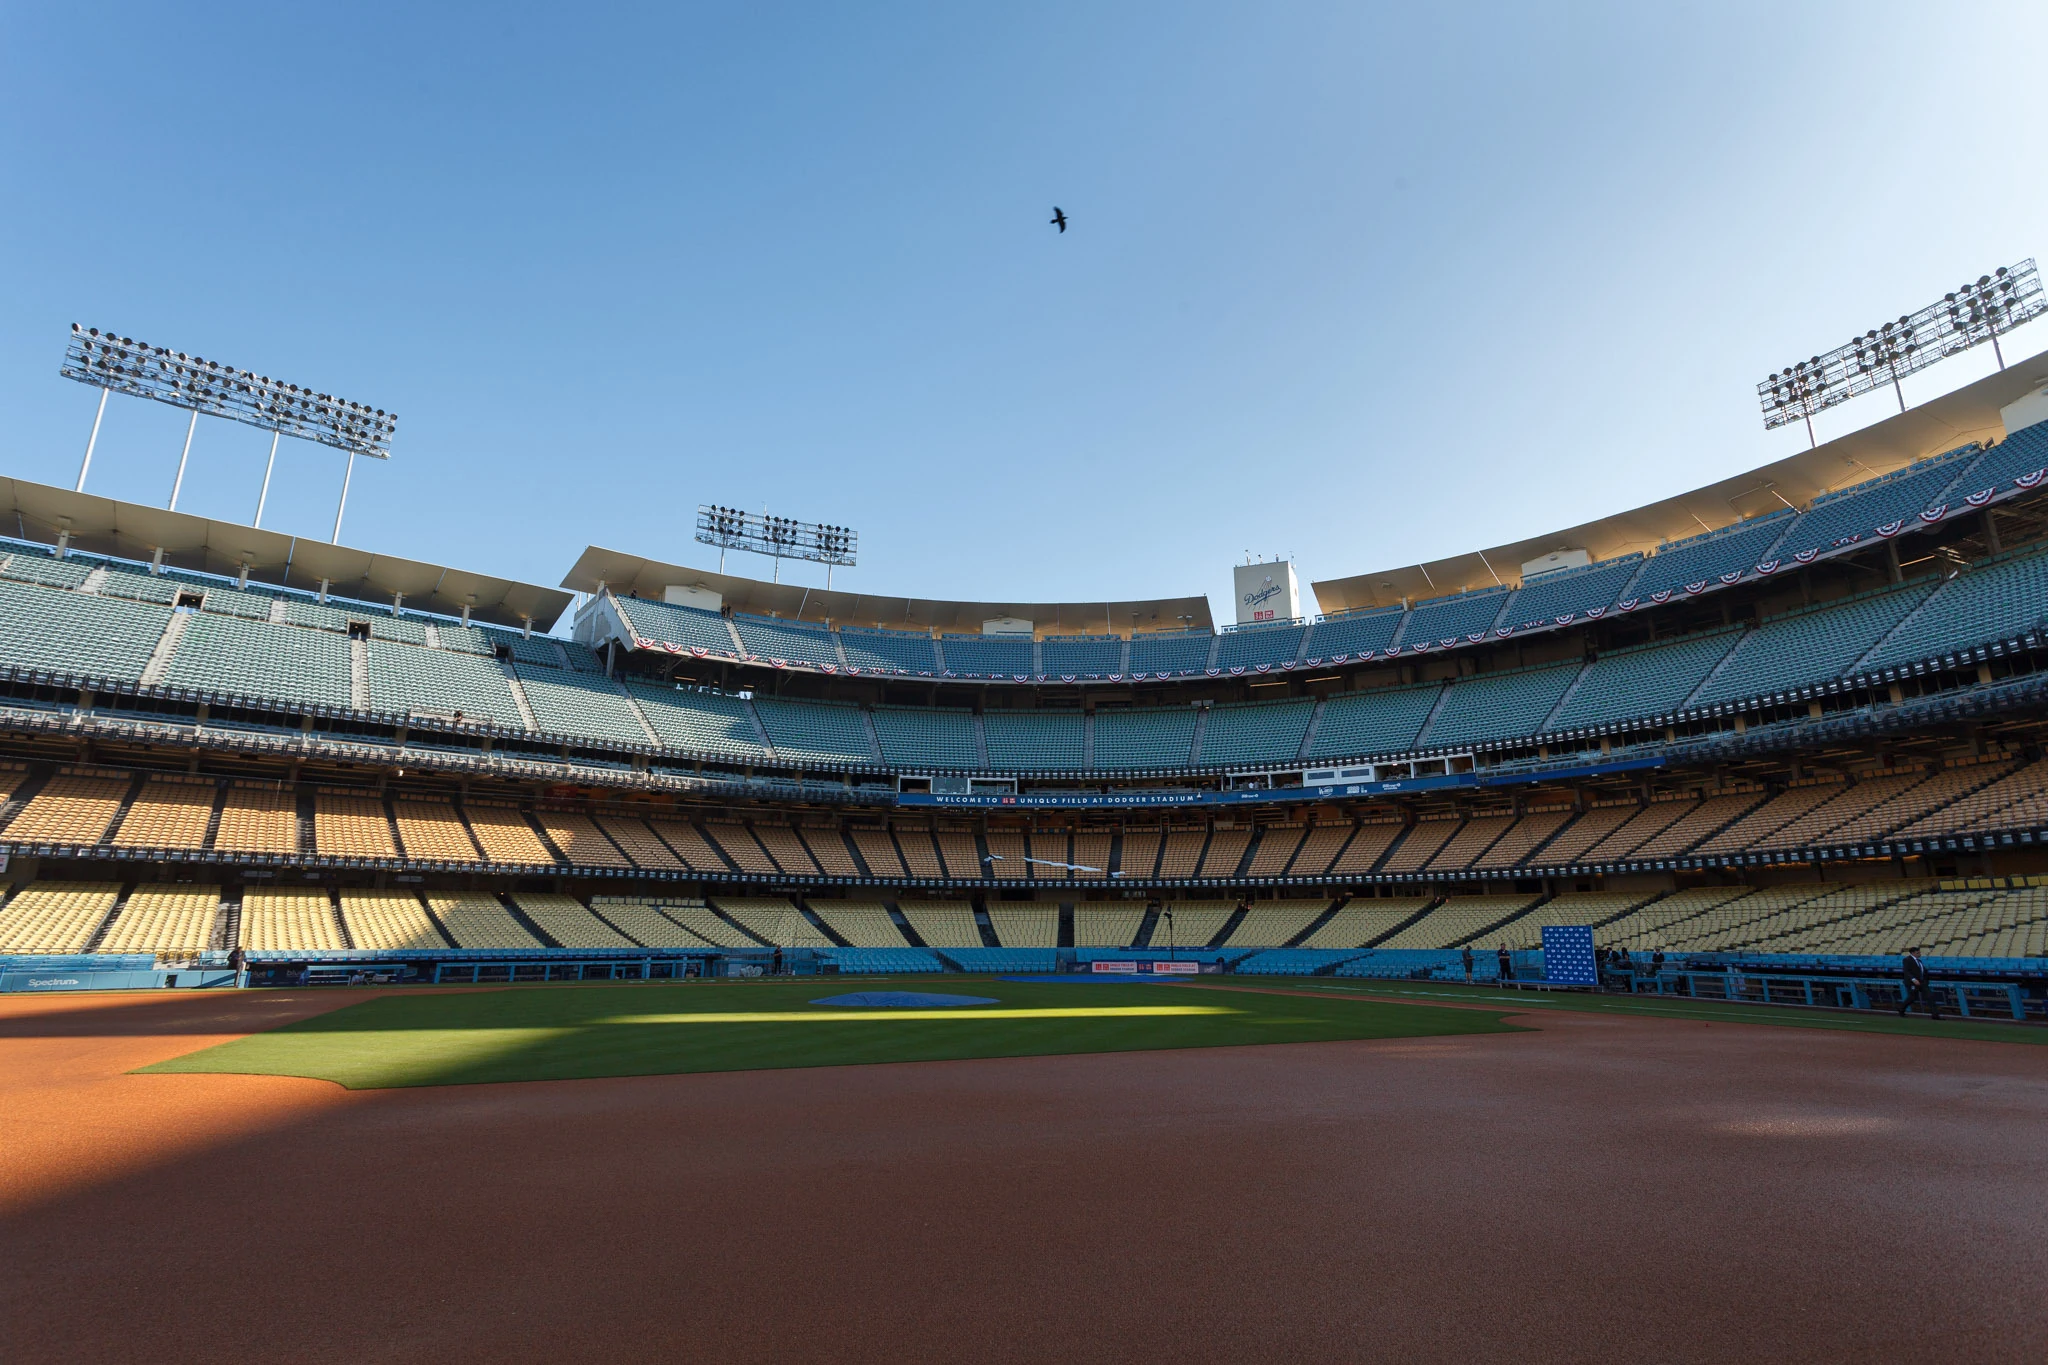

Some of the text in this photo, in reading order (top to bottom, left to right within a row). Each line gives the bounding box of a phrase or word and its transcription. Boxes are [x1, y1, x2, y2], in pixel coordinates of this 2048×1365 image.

[1244, 584, 1282, 605] Dodgers
[936, 796, 982, 804] WELCOME
[1151, 795, 1194, 803] STADIUM
[28, 978, 76, 988] Spectrum
